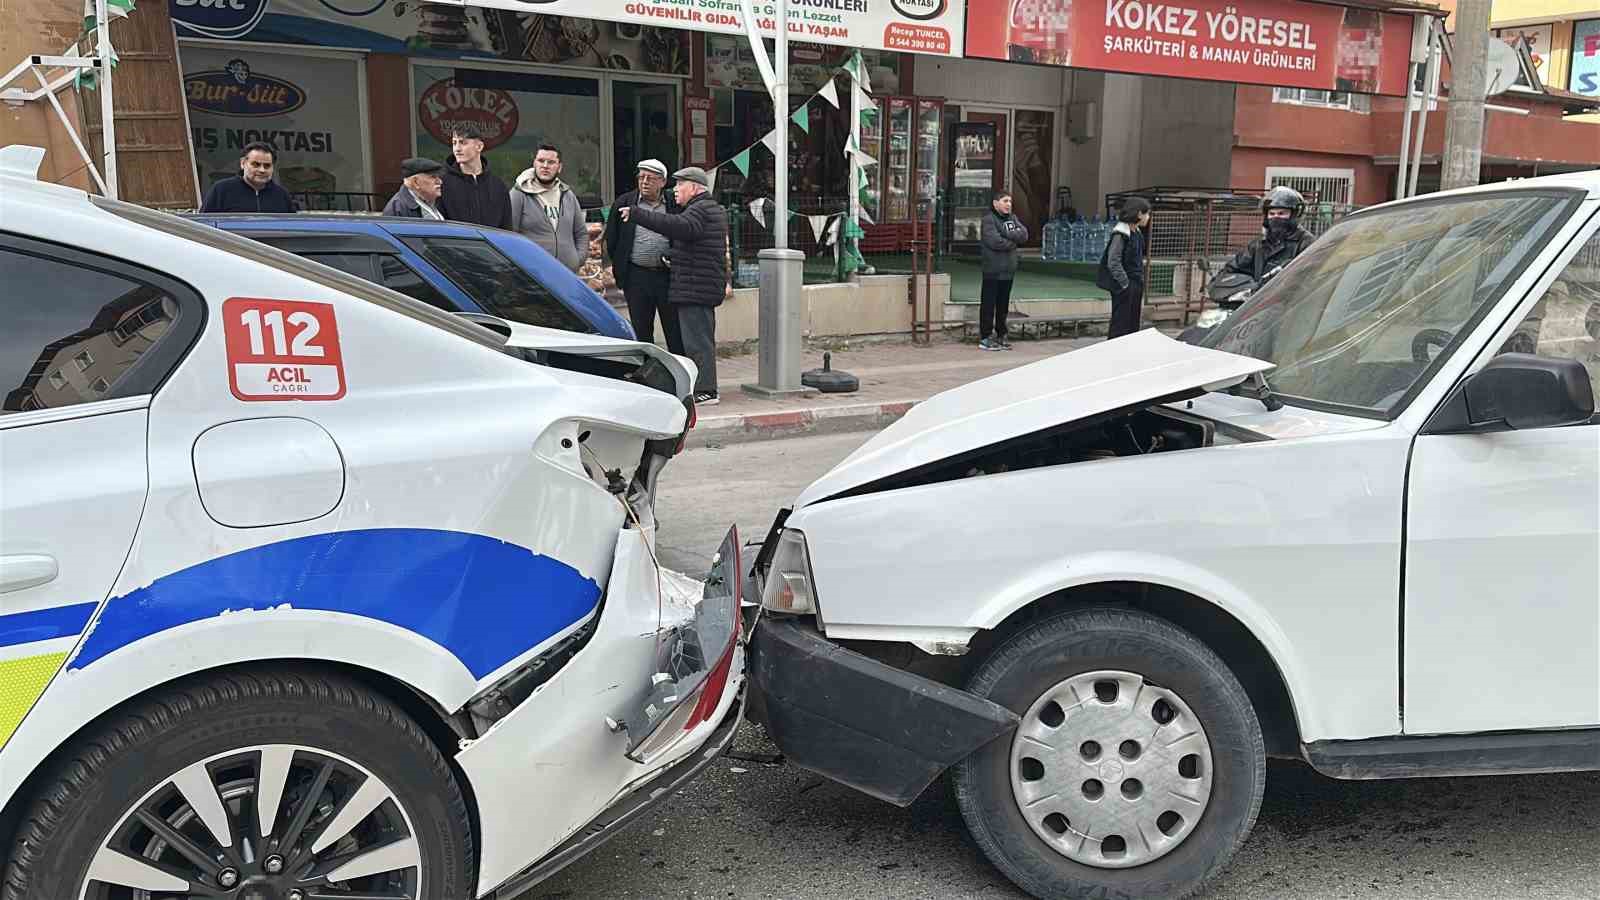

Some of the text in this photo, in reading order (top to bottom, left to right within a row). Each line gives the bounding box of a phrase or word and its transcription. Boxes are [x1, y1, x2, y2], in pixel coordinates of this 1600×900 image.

[625, 3, 702, 22] GÜVENİLİR
[705, 13, 742, 28] GIDA,
[807, 24, 848, 38] YAŞAM
[804, 10, 843, 23] Lezzet
[1205, 6, 1317, 51] YÖRESEL
[1103, 35, 1316, 71] ŞARKÜTERİ & MANAV ÜRÜNLERİ
[226, 128, 333, 153] NOKTASI
[240, 309, 325, 357] 112
